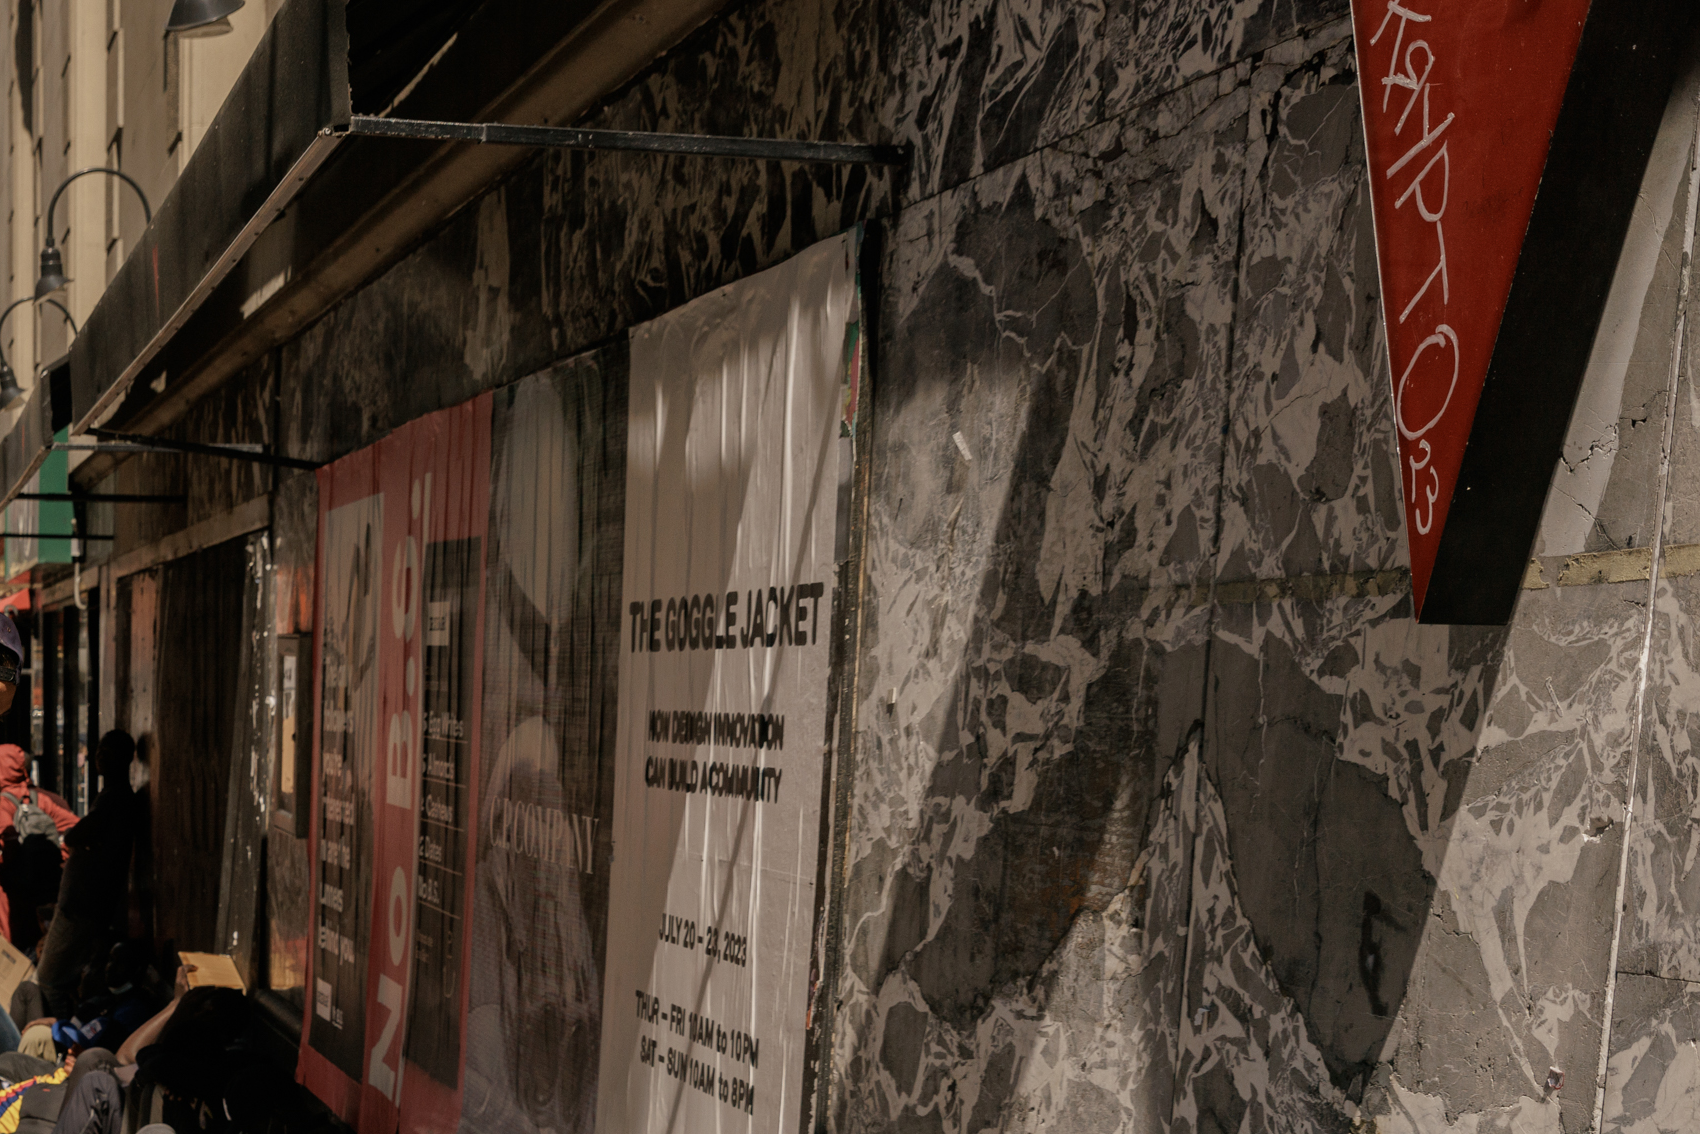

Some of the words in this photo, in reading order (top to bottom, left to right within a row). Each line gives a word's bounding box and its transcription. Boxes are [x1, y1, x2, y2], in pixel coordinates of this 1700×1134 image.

[629, 598, 662, 653] THE
[665, 591, 738, 652] GOGGLE
[740, 582, 824, 649] JACKET
[645, 755, 667, 789] CAN
[699, 760, 708, 795] A
[425, 836, 442, 862] Dates
[659, 913, 683, 945] JULY
[683, 919, 695, 950] 20
[705, 925, 721, 964] 23,
[723, 931, 747, 967] 2023
[635, 989, 660, 1025] THUR
[669, 1003, 686, 1037] FRI
[689, 1012, 715, 1049] 10AM
[716, 1023, 728, 1055] to
[731, 1029, 759, 1069] 10PM
[640, 1035, 657, 1067] SAT
[666, 1047, 688, 1082] SUN
[689, 1057, 715, 1097] 10AM
[718, 1072, 729, 1103] to
[731, 1077, 755, 1115] 8PM
